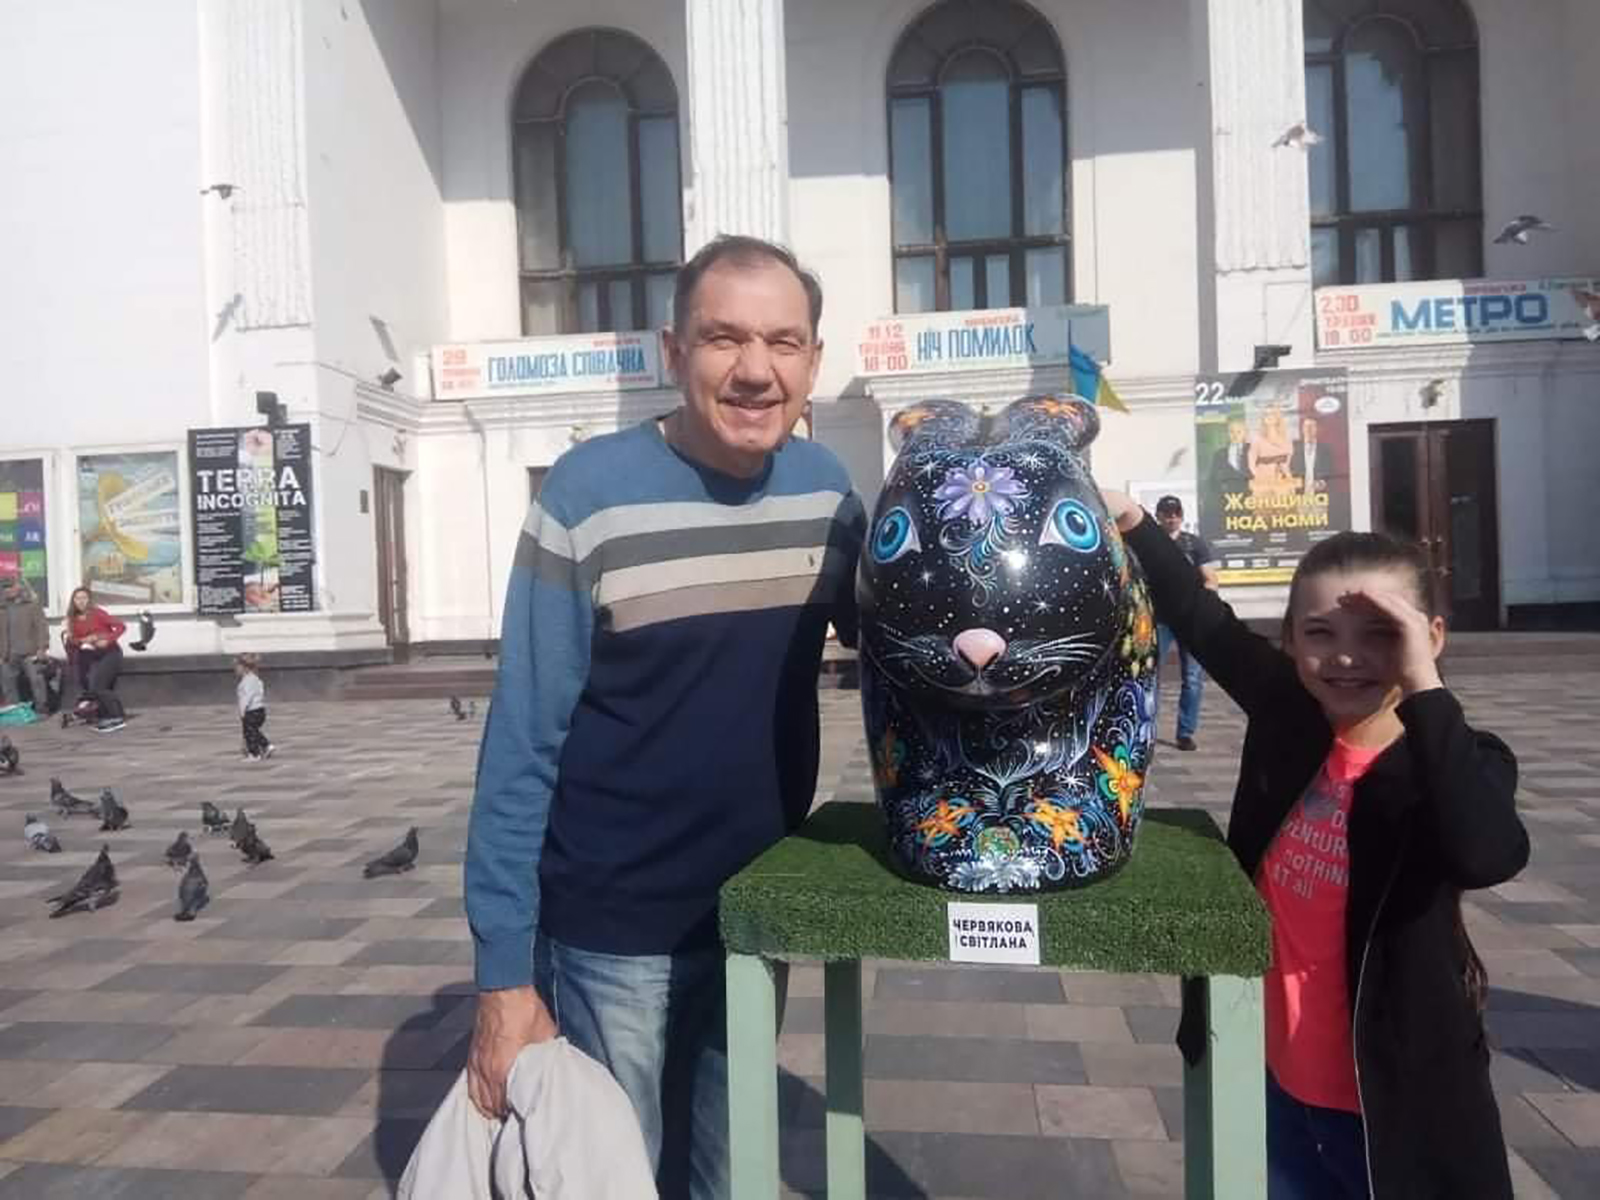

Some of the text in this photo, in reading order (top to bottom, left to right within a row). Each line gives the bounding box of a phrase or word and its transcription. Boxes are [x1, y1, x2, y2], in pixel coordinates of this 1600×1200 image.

[1391, 292, 1548, 331] МЕТРО
[949, 322, 1037, 359] ПОМИЛОК
[488, 347, 646, 382] ГОЛОМОЗА СПІВАЧКА
[1196, 382, 1224, 405] 22
[197, 466, 301, 493] TERRA
[197, 490, 307, 510] INCOGNITA
[1224, 492, 1329, 511] Женщина
[1226, 513, 1329, 531] над нами
[953, 919, 1034, 934] ЧЕРВЯКОВА
[959, 935, 1027, 949] СВІТЛАНА
